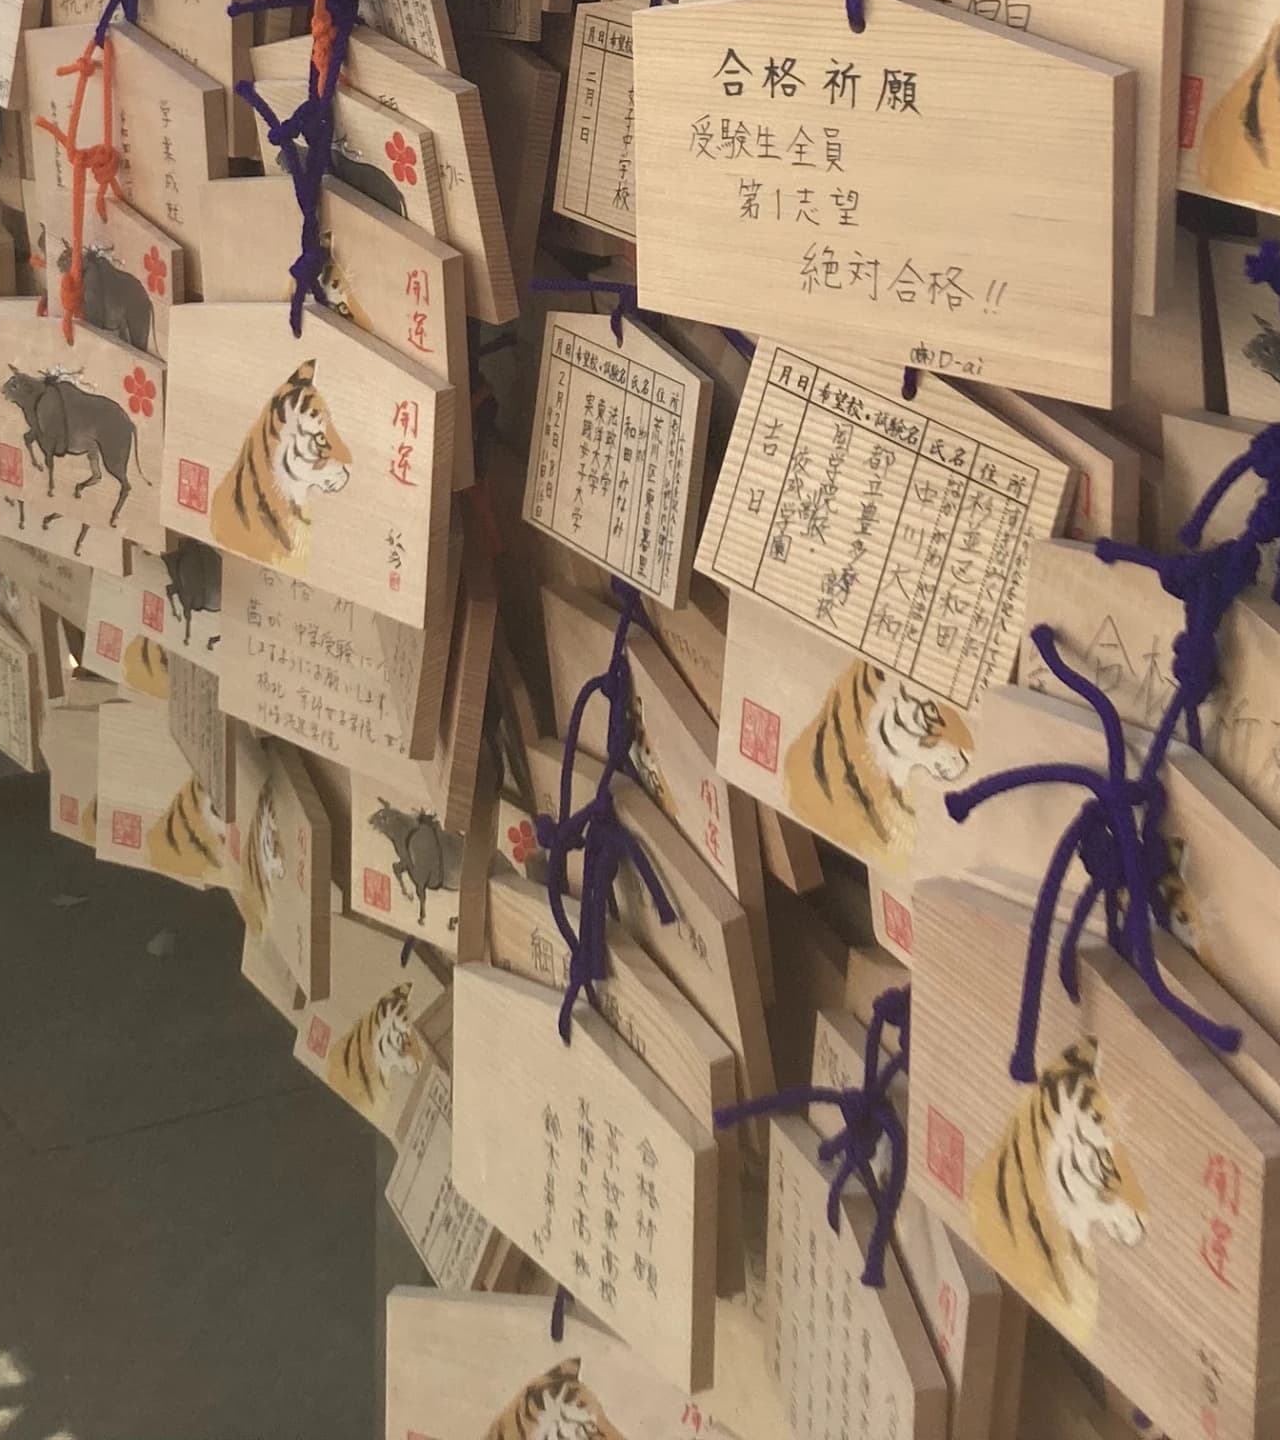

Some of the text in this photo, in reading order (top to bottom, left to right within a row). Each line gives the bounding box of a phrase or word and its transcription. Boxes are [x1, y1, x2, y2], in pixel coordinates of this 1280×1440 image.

[712, 46, 922, 116] 合格祈願
[688, 111, 846, 174] 受験生全員
[404, 267, 436, 354] 開運
[629, 373, 651, 397] 氏名
[776, 364, 812, 394] 月日
[388, 398, 422, 490] 開運
[746, 415, 786, 516] 吉日
[927, 436, 967, 470] 氏名
[978, 461, 1028, 502] 住所
